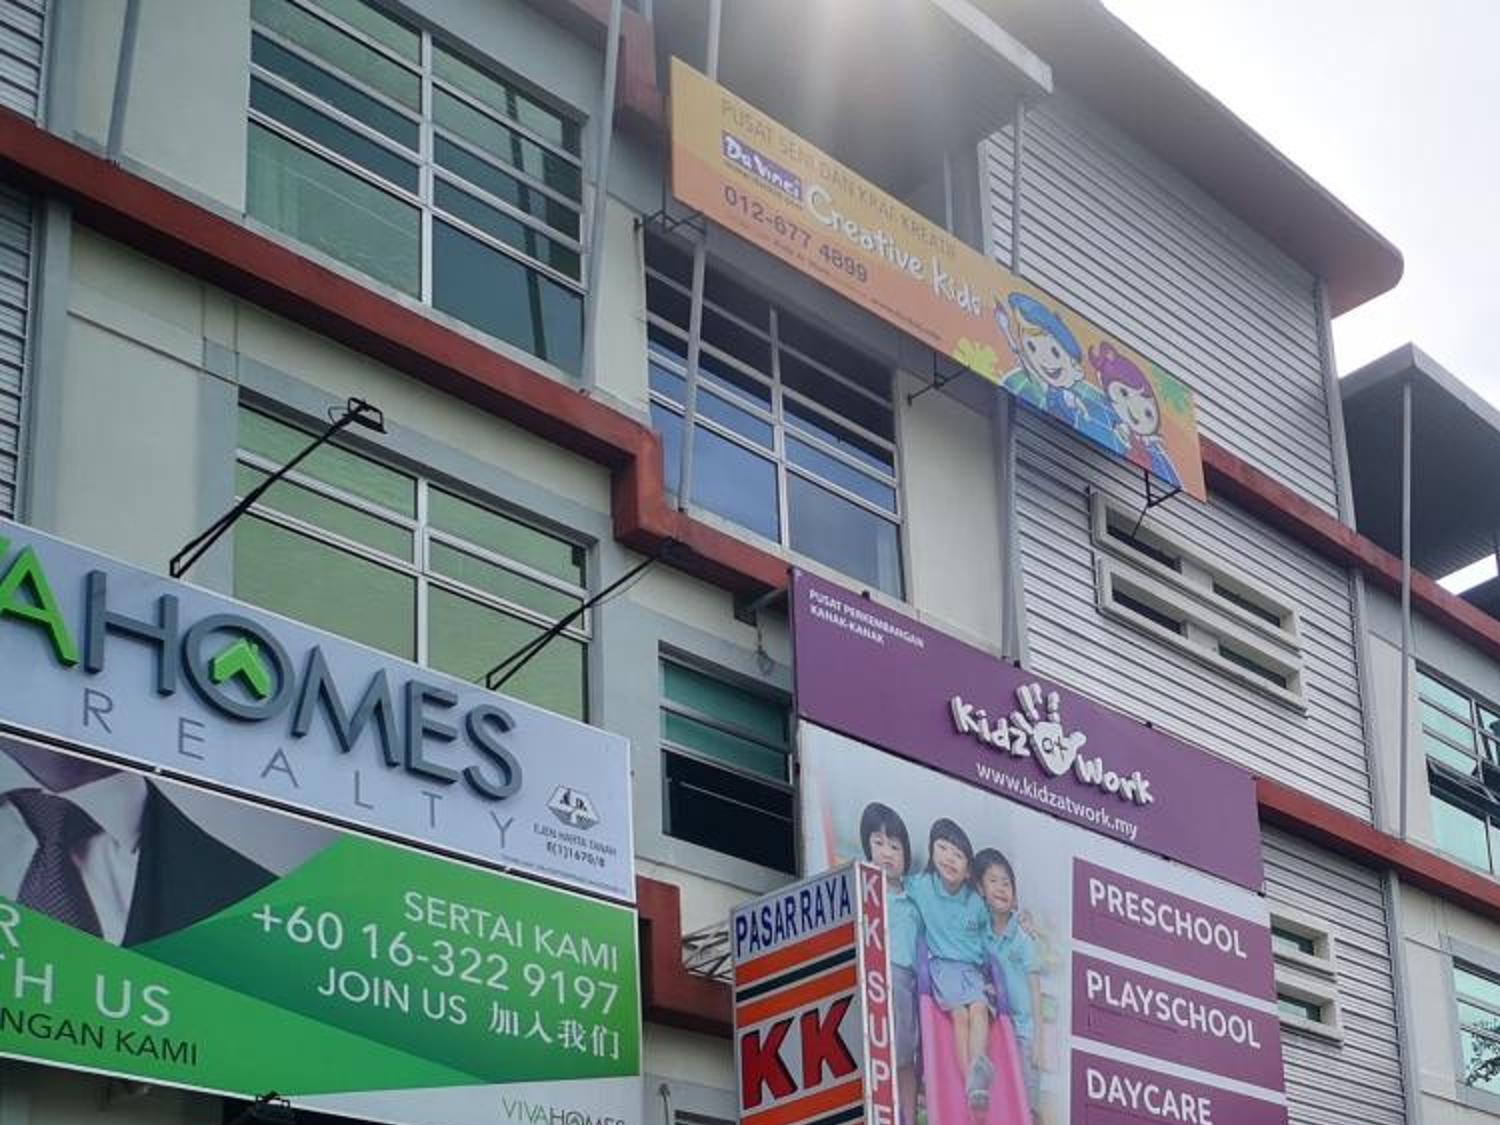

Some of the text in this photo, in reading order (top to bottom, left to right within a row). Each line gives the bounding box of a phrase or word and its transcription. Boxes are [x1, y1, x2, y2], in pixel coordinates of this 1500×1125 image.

[724, 186, 869, 283] 012-677 4899
[806, 184, 926, 281] Creative
[0, 535, 523, 801] AHOMES
[83, 688, 513, 850] REALTY
[976, 762, 1138, 841] www.kidzatwork.my
[404, 891, 617, 974] SERTAI KAMI
[735, 875, 852, 958] PASAR RAYA
[1088, 878, 1248, 959] PRESCHOOL
[95, 973, 170, 1027] US
[252, 903, 619, 1015] +60 16-322 9197
[318, 967, 467, 1025] JOIN US
[116, 1029, 197, 1066] KAMI
[1086, 968, 1261, 1049] PLAYSCHOOL
[741, 995, 859, 1111] KK
